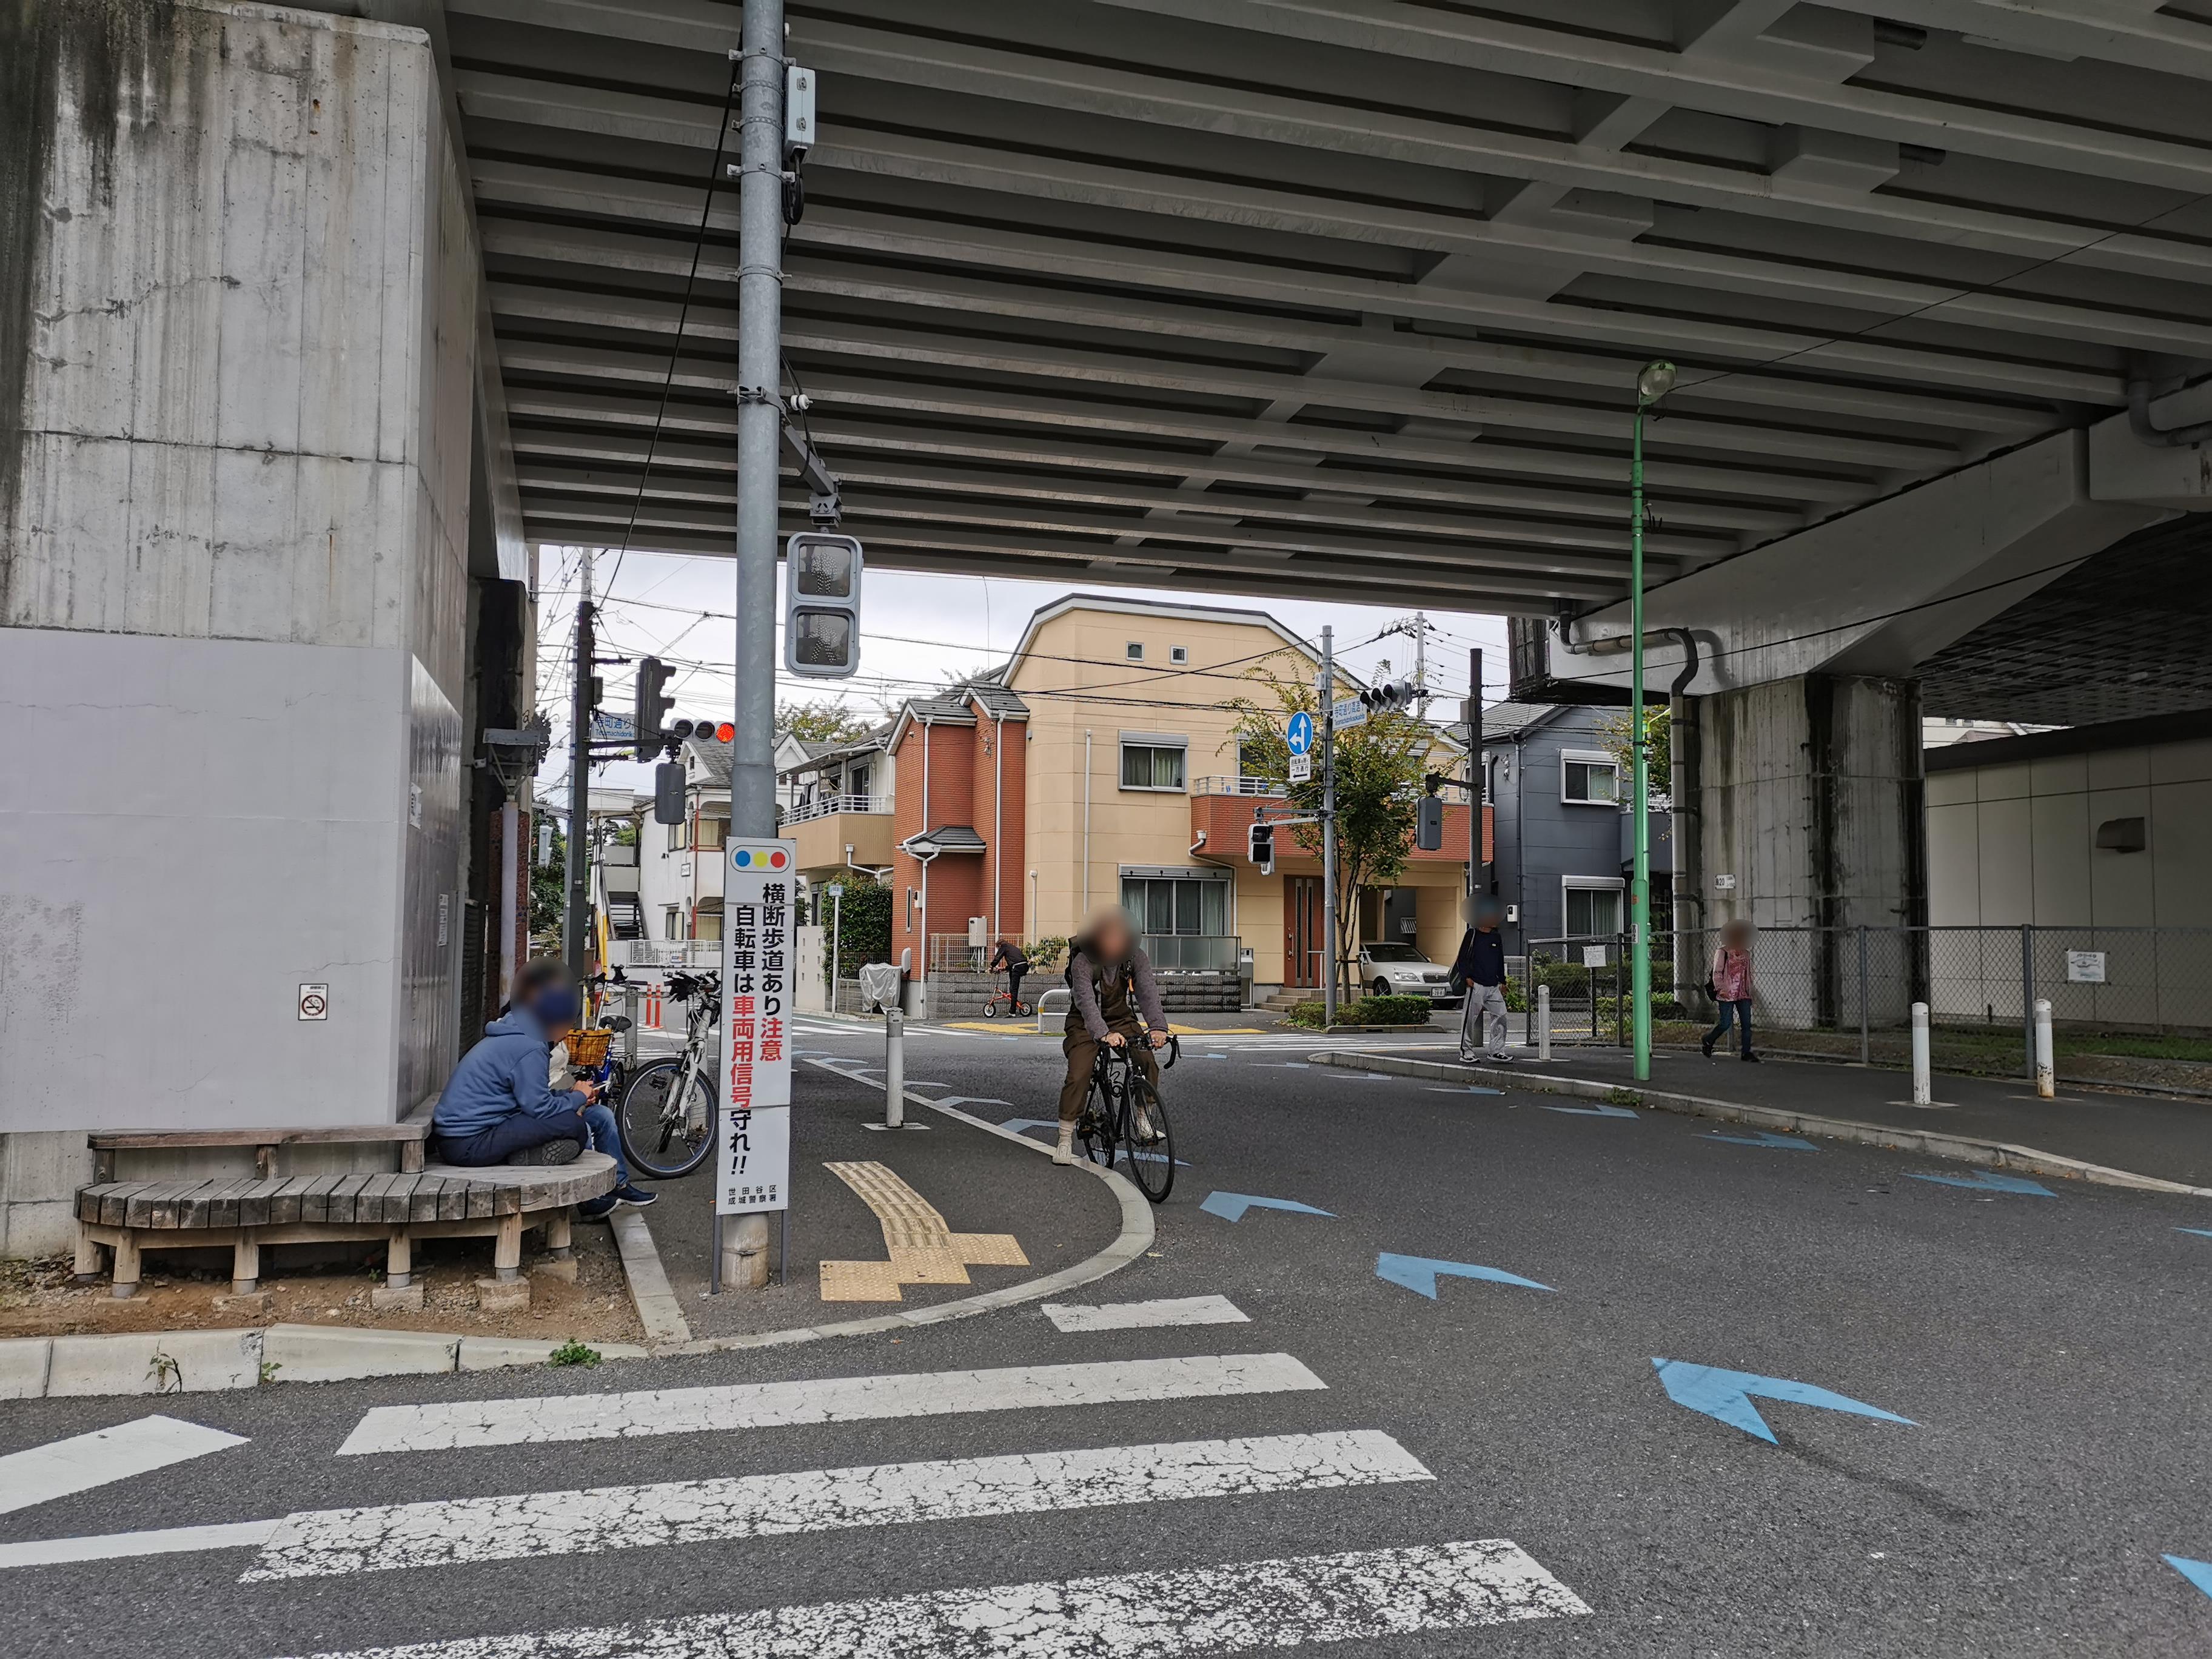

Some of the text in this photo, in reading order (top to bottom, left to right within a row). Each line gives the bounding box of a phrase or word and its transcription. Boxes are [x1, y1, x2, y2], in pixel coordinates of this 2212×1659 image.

[596, 716, 635, 729] 寺町通り
[760, 883, 786, 1061] 横断歩道あり注意
[729, 905, 756, 1175] 自転車は車両用信号守れ!!
[728, 1185, 777, 1196] 世田谷区
[728, 1194, 776, 1205] 成城警察署
